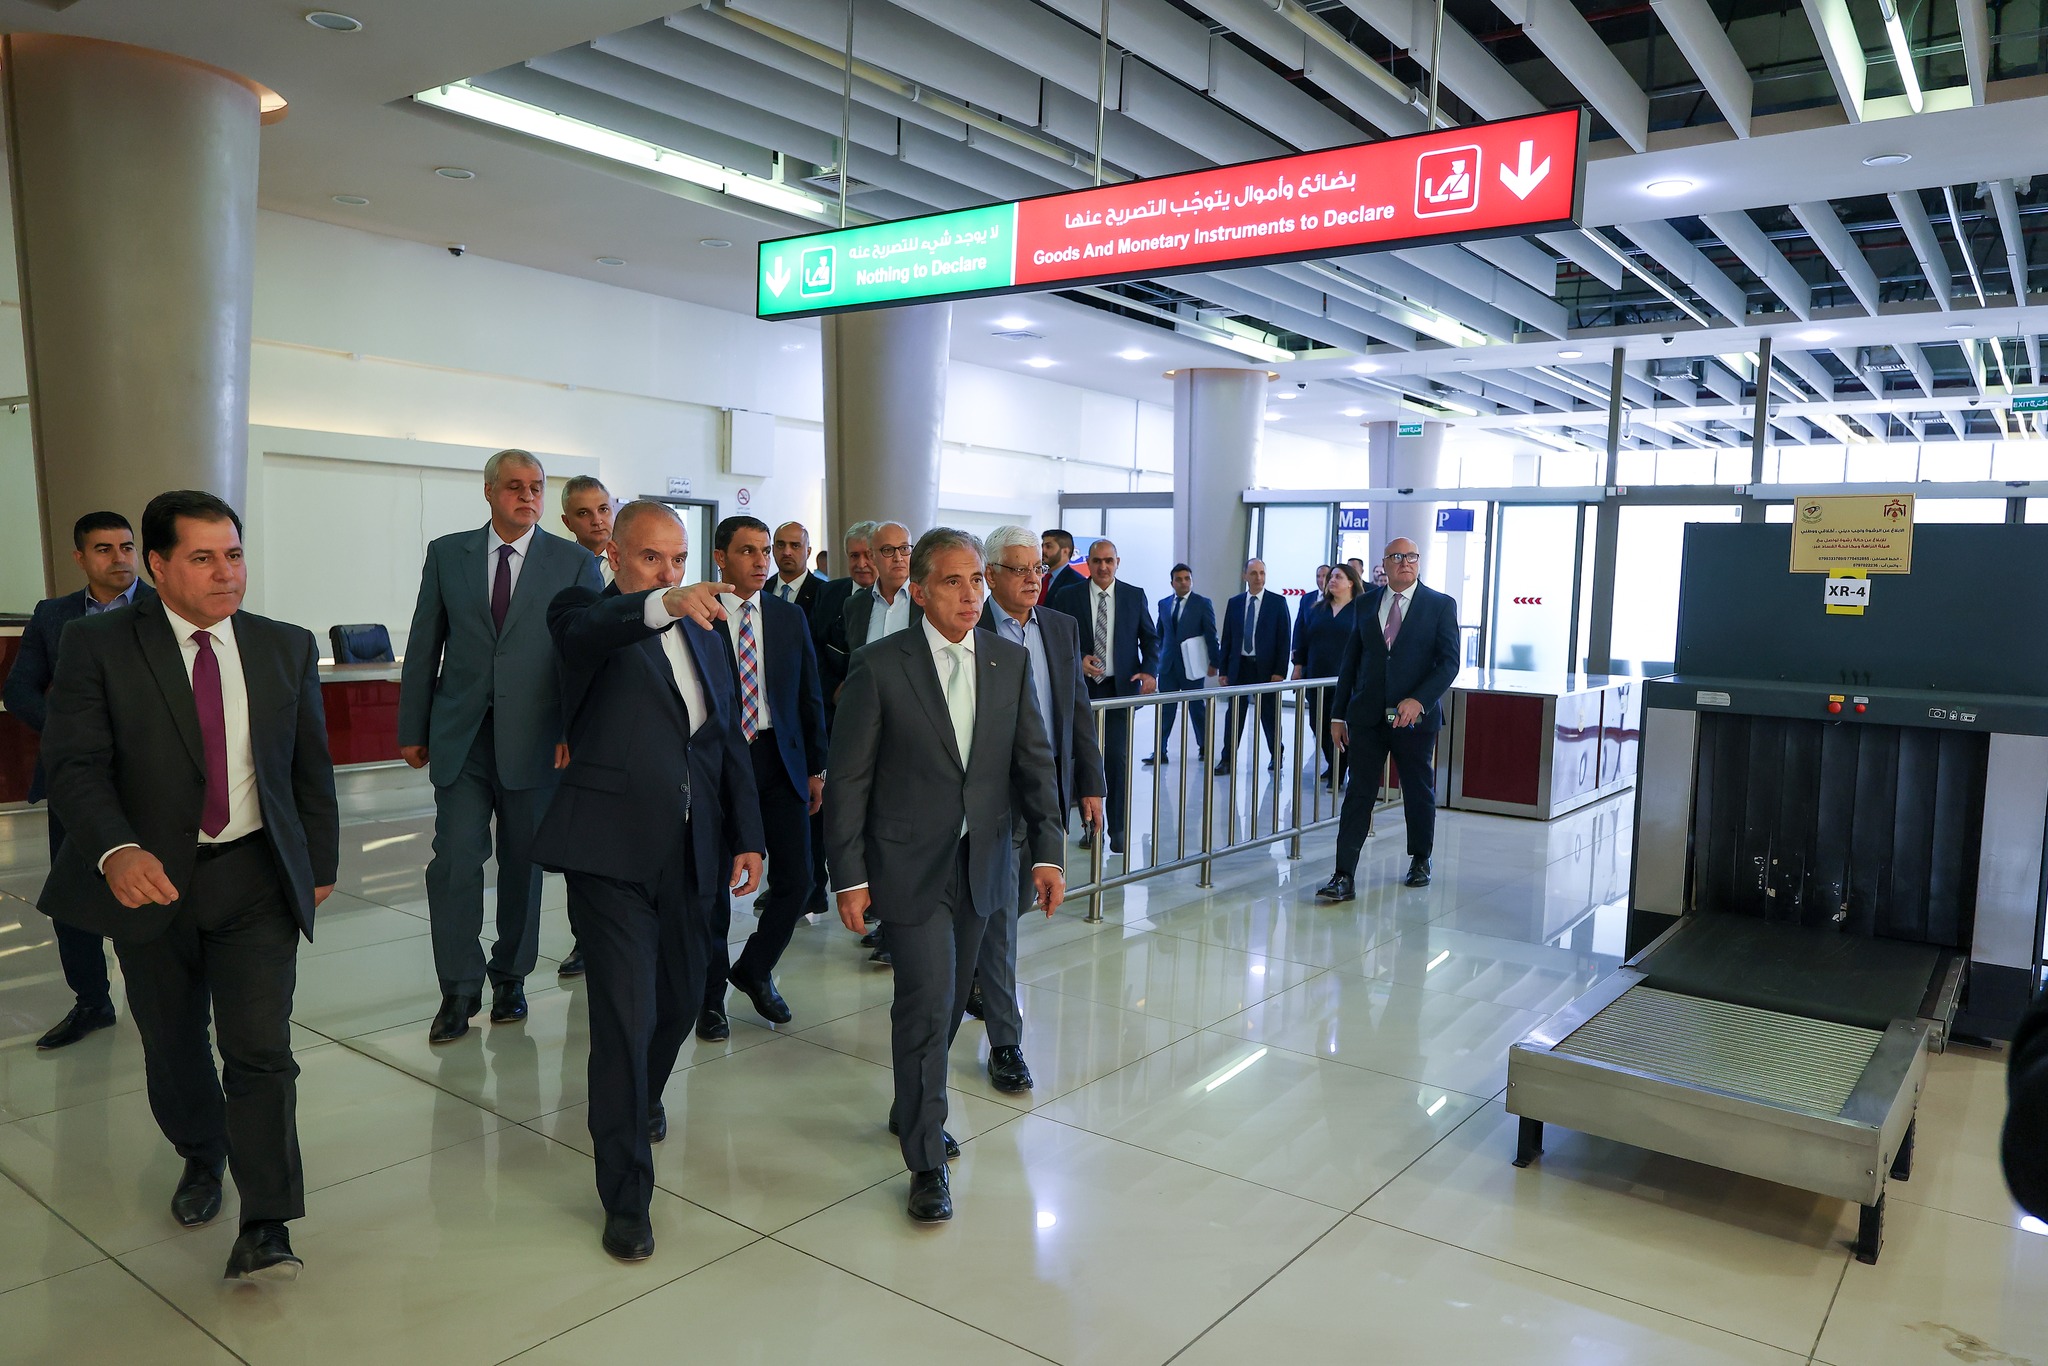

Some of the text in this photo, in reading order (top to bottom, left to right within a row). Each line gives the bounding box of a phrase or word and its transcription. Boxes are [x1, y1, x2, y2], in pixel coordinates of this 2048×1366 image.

[1234, 176, 1294, 207] وأموال
[1298, 170, 1356, 199] بضائع
[1064, 210, 1102, 229] عنها
[1105, 199, 1167, 227] التصريح
[848, 224, 999, 259] لا يوجد شيء للتصريح عنه
[1033, 204, 1395, 266] Goods And Monetary Instruments to Declare
[856, 256, 987, 286] Nothing to Declare
[1339, 511, 1368, 528] Mar
[1438, 511, 1450, 528] P
[1828, 585, 1866, 597] XR-4
